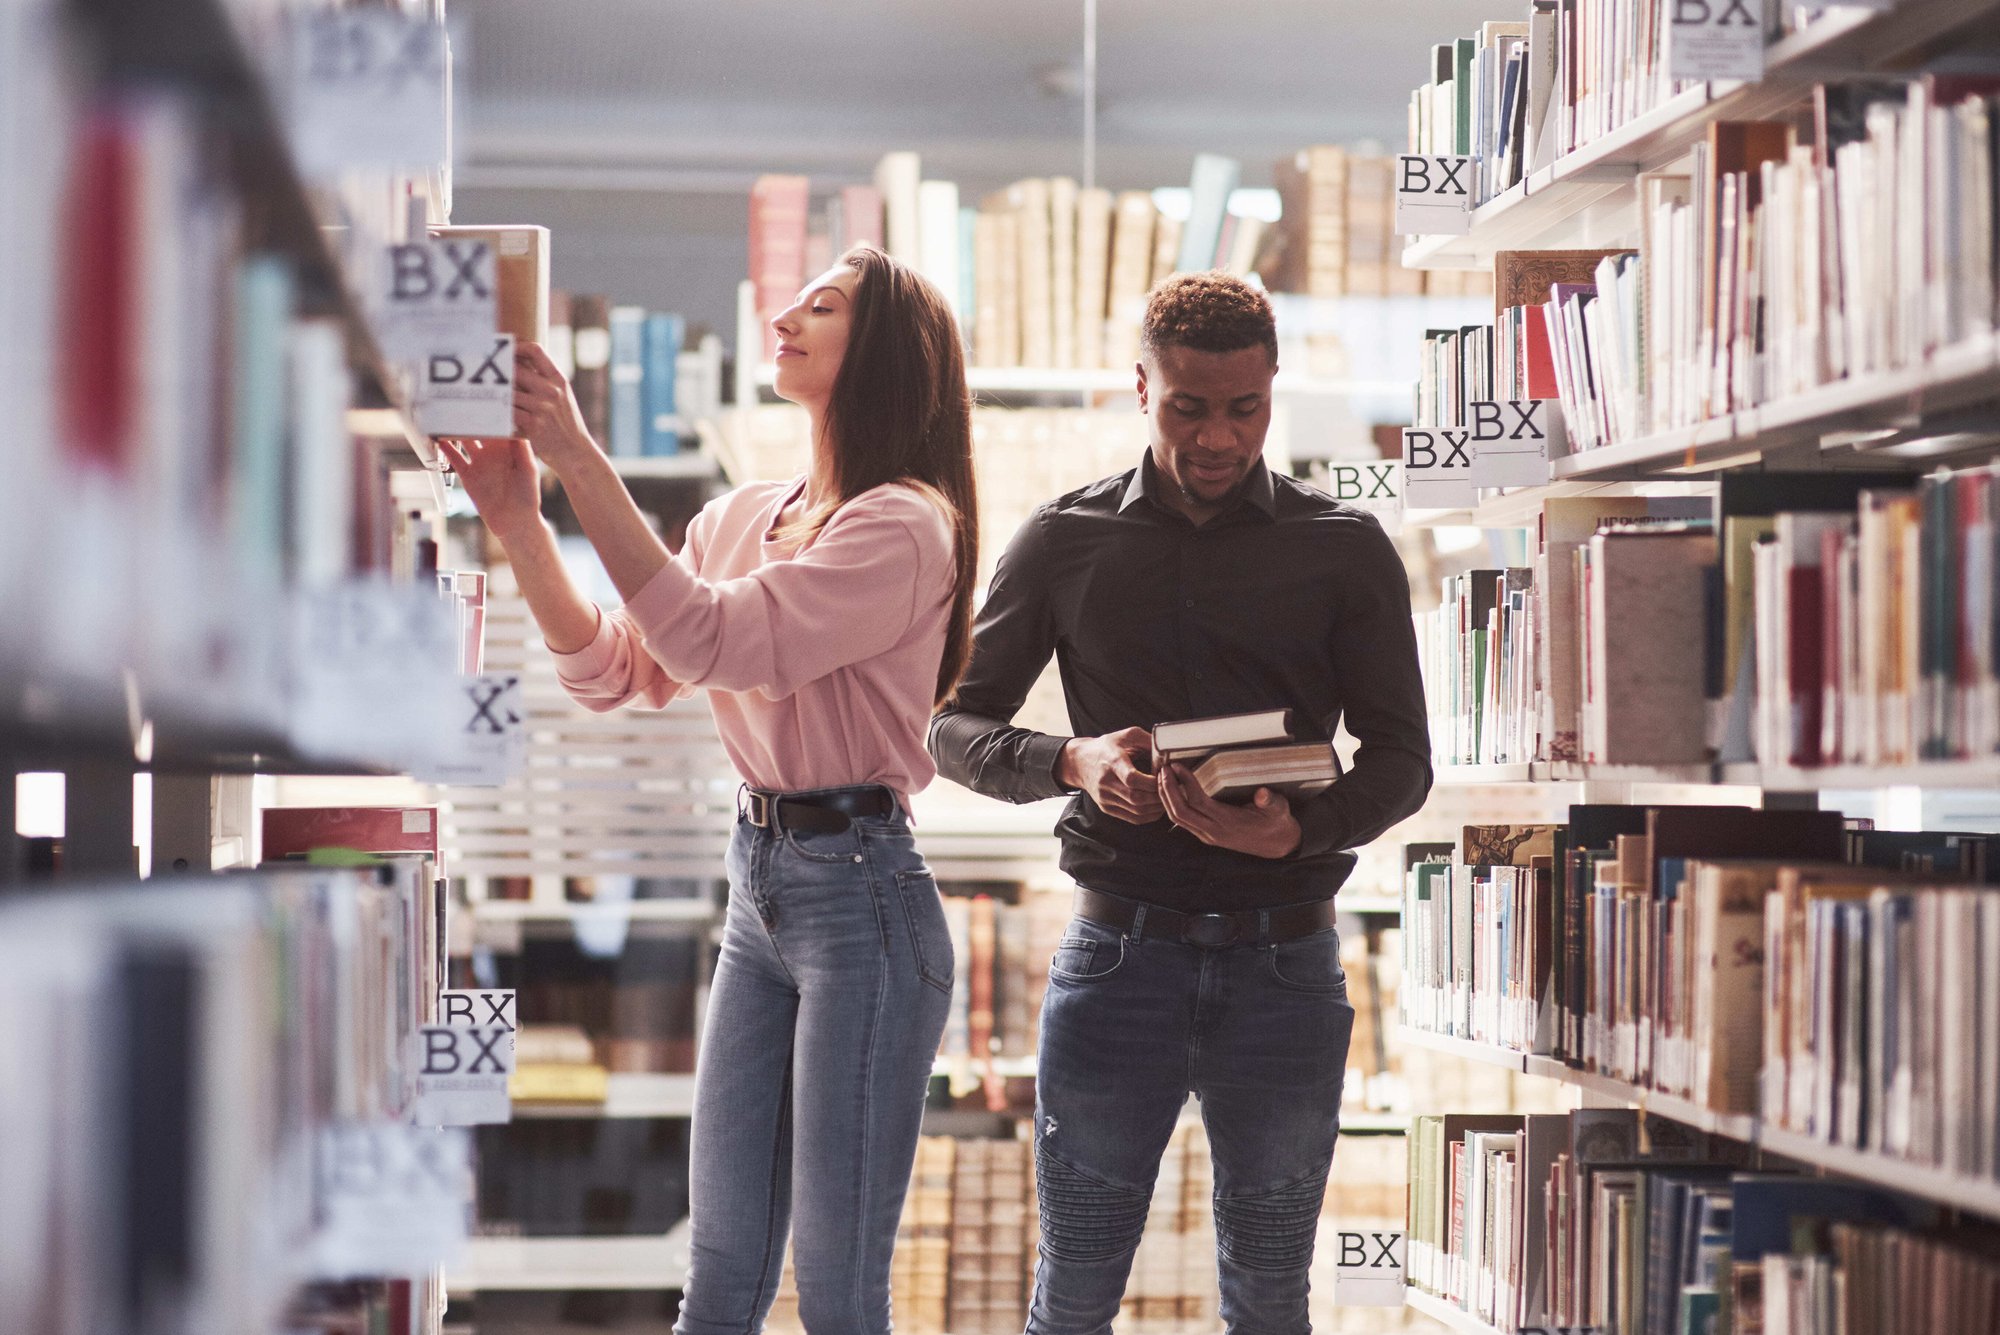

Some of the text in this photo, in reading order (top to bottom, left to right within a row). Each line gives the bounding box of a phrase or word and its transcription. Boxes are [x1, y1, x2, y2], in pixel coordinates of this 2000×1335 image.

[1399, 156, 1467, 195] BX
[385, 243, 489, 300] BX
[1470, 400, 1544, 441] BX
[1405, 431, 1470, 469] BX
[1332, 465, 1397, 500] BX
[464, 685, 504, 735] X
[420, 1029, 506, 1075] BX
[1336, 1232, 1402, 1268] BX
